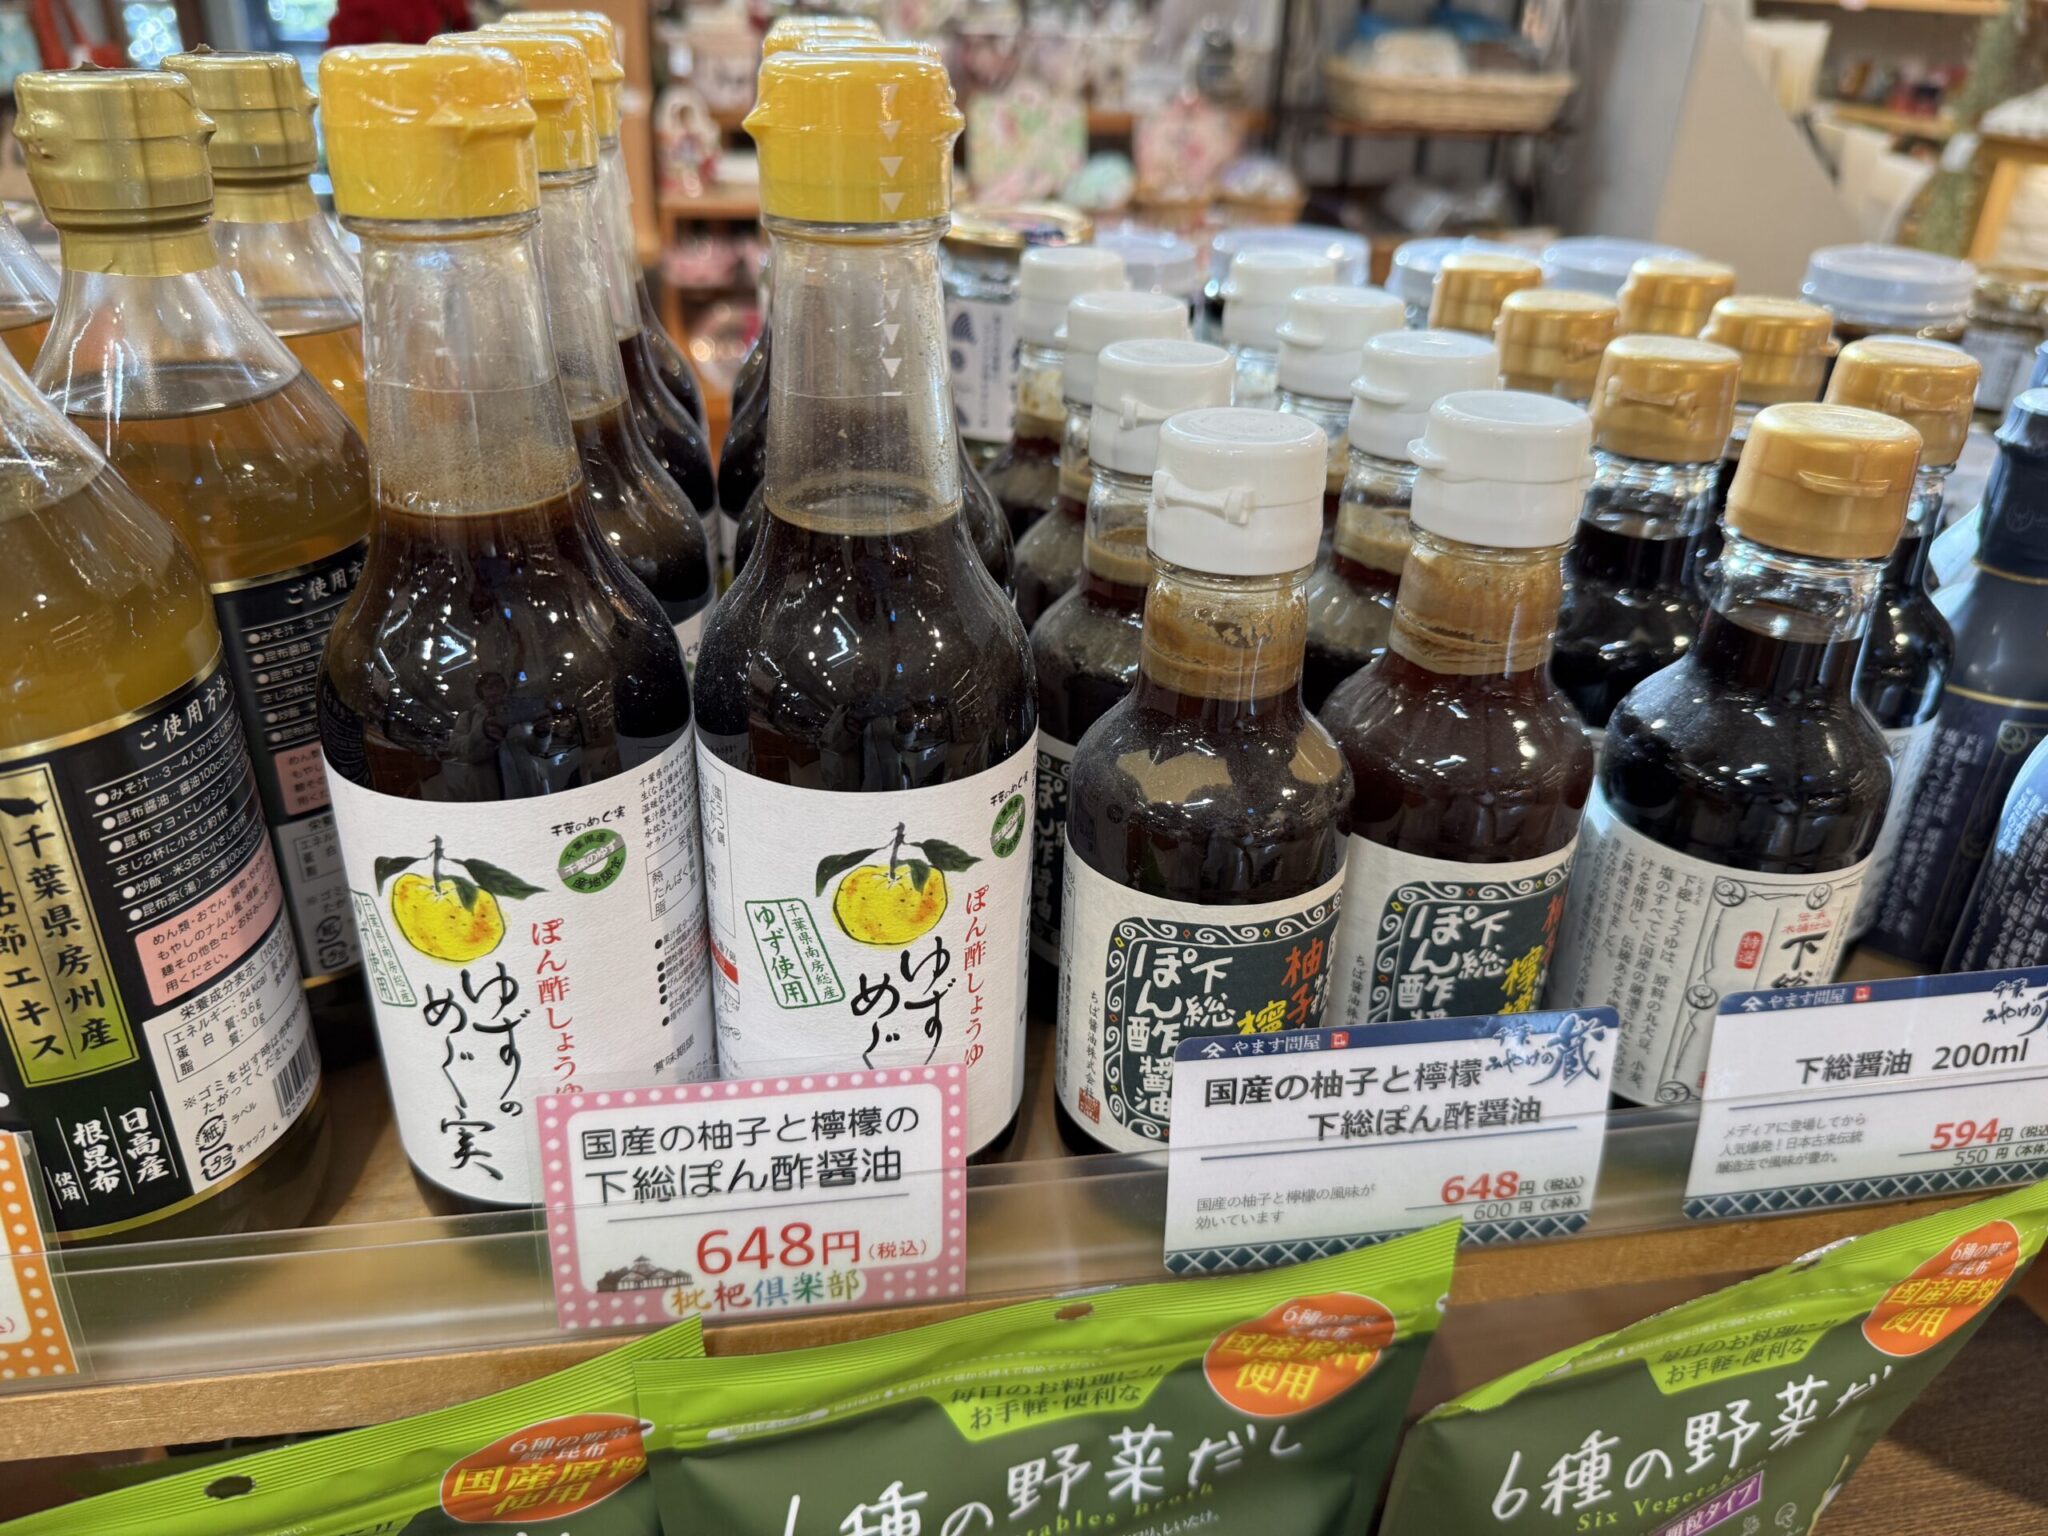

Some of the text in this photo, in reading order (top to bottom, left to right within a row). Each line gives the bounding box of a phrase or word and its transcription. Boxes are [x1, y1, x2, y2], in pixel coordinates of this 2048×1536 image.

[140, 674, 228, 750] ご使用方法
[551, 805, 626, 837] 千葉のめぐ実
[14, 824, 119, 1053] 千葉県房州産
[754, 906, 810, 1004] ゆず使用
[786, 904, 840, 1000] 千葉県南房総産
[1398, 904, 1481, 1018] ぽん酢
[1458, 910, 1512, 979] 下総
[166, 952, 229, 994] 用ください。
[180, 961, 257, 1022] 栄養成分表示
[963, 885, 991, 1068] ぽん酢しょうゆ
[1183, 956, 1236, 1028] 下総
[1281, 937, 1325, 1026] 柚子
[1346, 953, 1368, 1025] ちば醤油株
[1768, 987, 1848, 1010] やます問屋
[462, 961, 532, 1116] ゆずの
[653, 1033, 695, 1076] 賞味期限
[1127, 943, 1198, 1119] ぽん酢醤油
[1232, 1033, 1321, 1057] やます問屋
[423, 983, 504, 1181] めぐ実
[1205, 1058, 1483, 1107] 国産の柚子と檸檬
[1796, 1038, 2030, 1085] 下総醤油 200ml
[231, 1101, 257, 1125] ラベル
[582, 1105, 919, 1161] 国産の柚子と檸檬の
[1308, 1095, 1542, 1141] 下総ぽん酢醤油
[73, 1118, 122, 1194] 根昆布
[119, 1106, 170, 1185] 日高産
[237, 1125, 268, 1154] キャップ
[1954, 1148, 1989, 1166] 550
[55, 1172, 81, 1202] 使用
[585, 1145, 902, 1206] 下総ぽん酢醤油
[1197, 1183, 1376, 1212] 国産の柚子と檸檬の風味が
[1195, 1210, 1285, 1231] 効いています
[1474, 1202, 1512, 1220] 600
[1885, 1277, 2004, 1309] 国産原料
[1881, 1306, 1951, 1337] 使用
[1236, 1361, 1320, 1400] 使用
[1664, 1337, 1808, 1385] お手軽・便利な
[970, 1385, 1141, 1430] お手軽・便利な
[451, 1456, 647, 1497] 国産原料
[492, 1481, 591, 1517] 使用
[784, 1422, 1302, 1536] 種の野菜だし
[1576, 1509, 1619, 1532] Six
